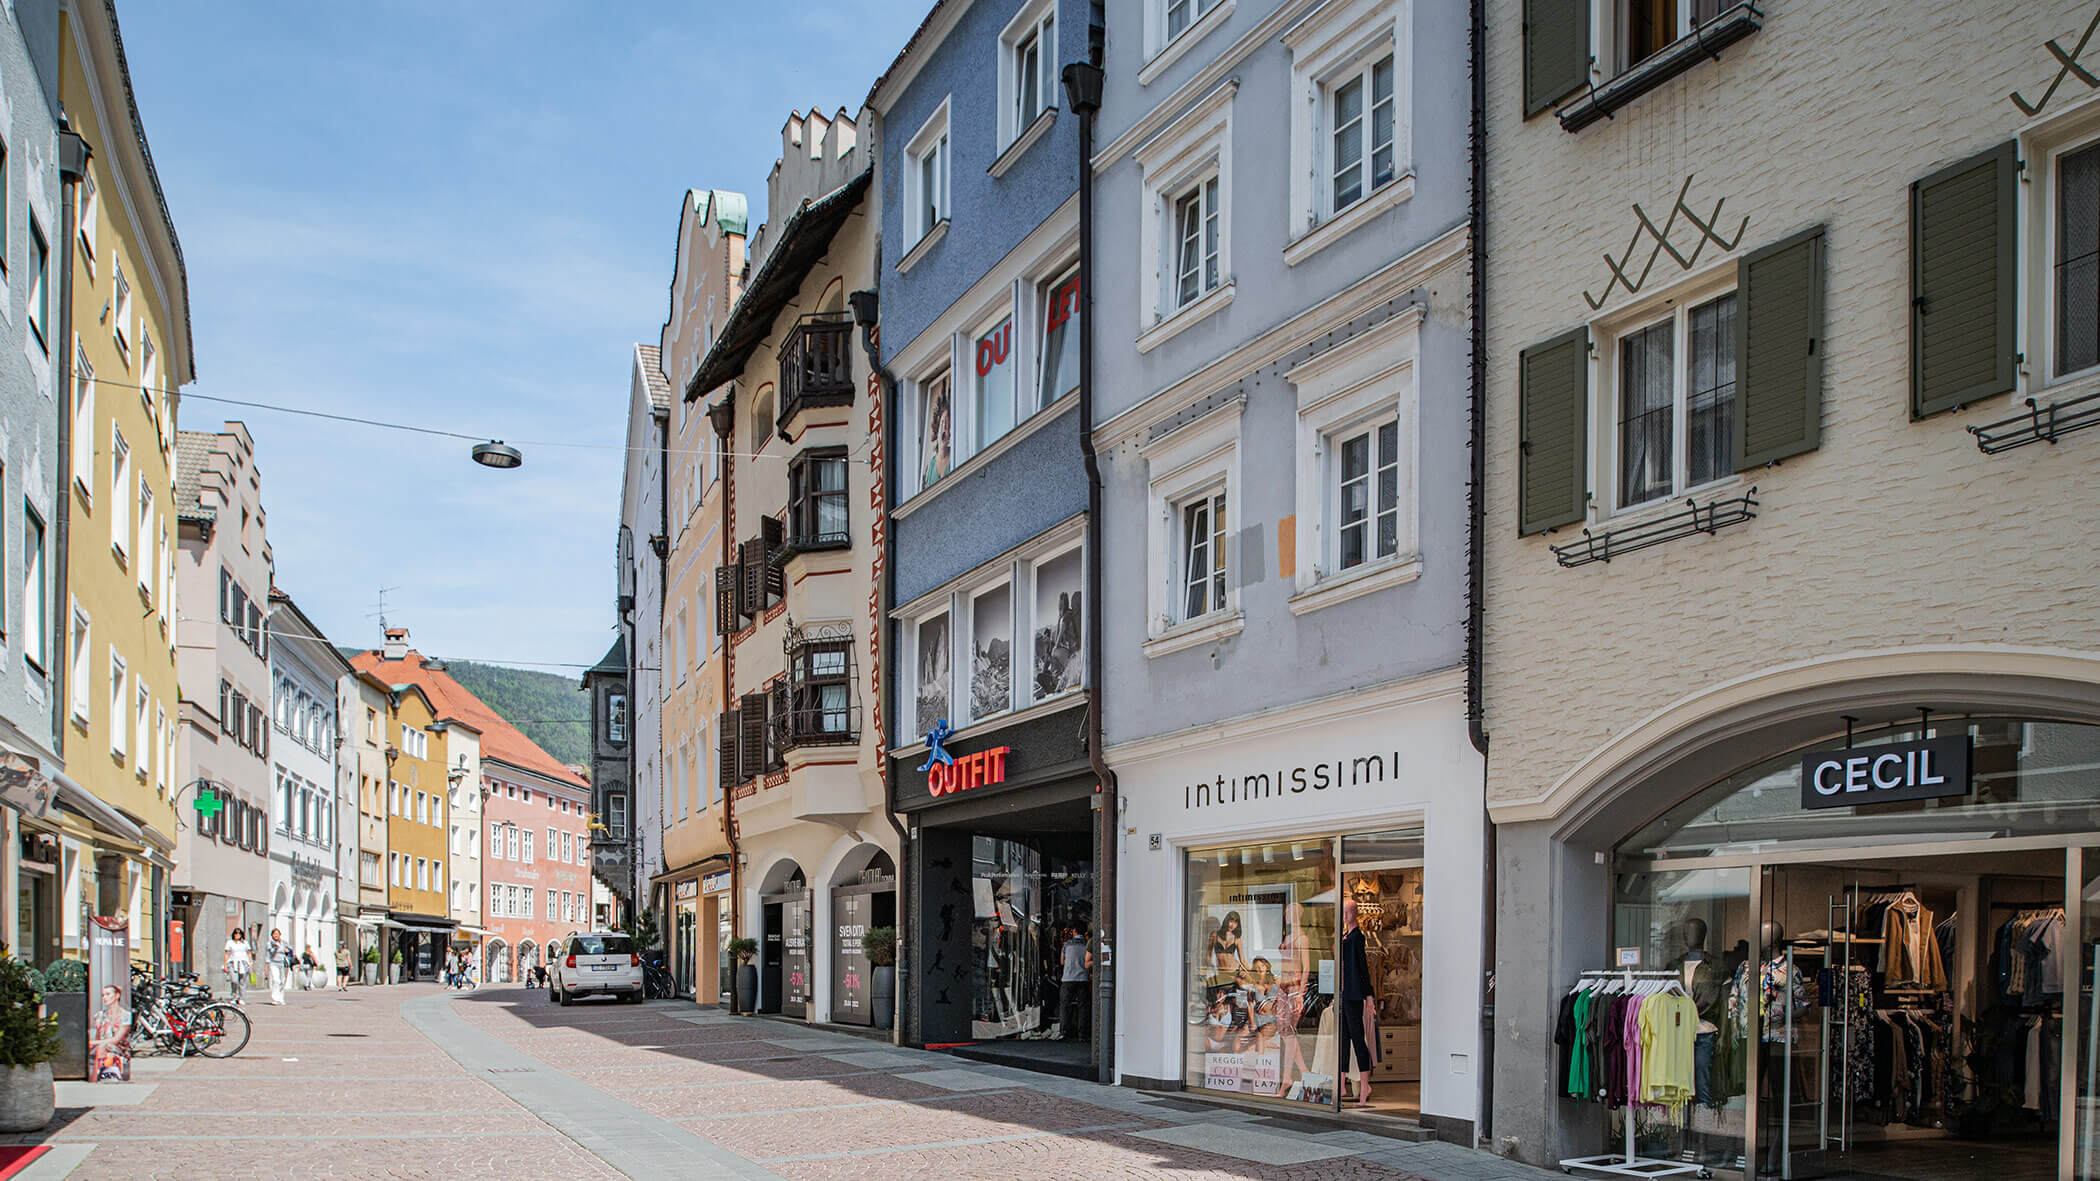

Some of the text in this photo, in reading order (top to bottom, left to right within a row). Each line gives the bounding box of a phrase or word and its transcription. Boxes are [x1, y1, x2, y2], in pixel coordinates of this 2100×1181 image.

[928, 746, 1010, 797] OUTFIT
[1185, 751, 1399, 809] intimissimi
[1813, 749, 1945, 796] CECIL
[1150, 836, 1159, 846] 54
[1207, 1077, 1234, 1087] FINO
